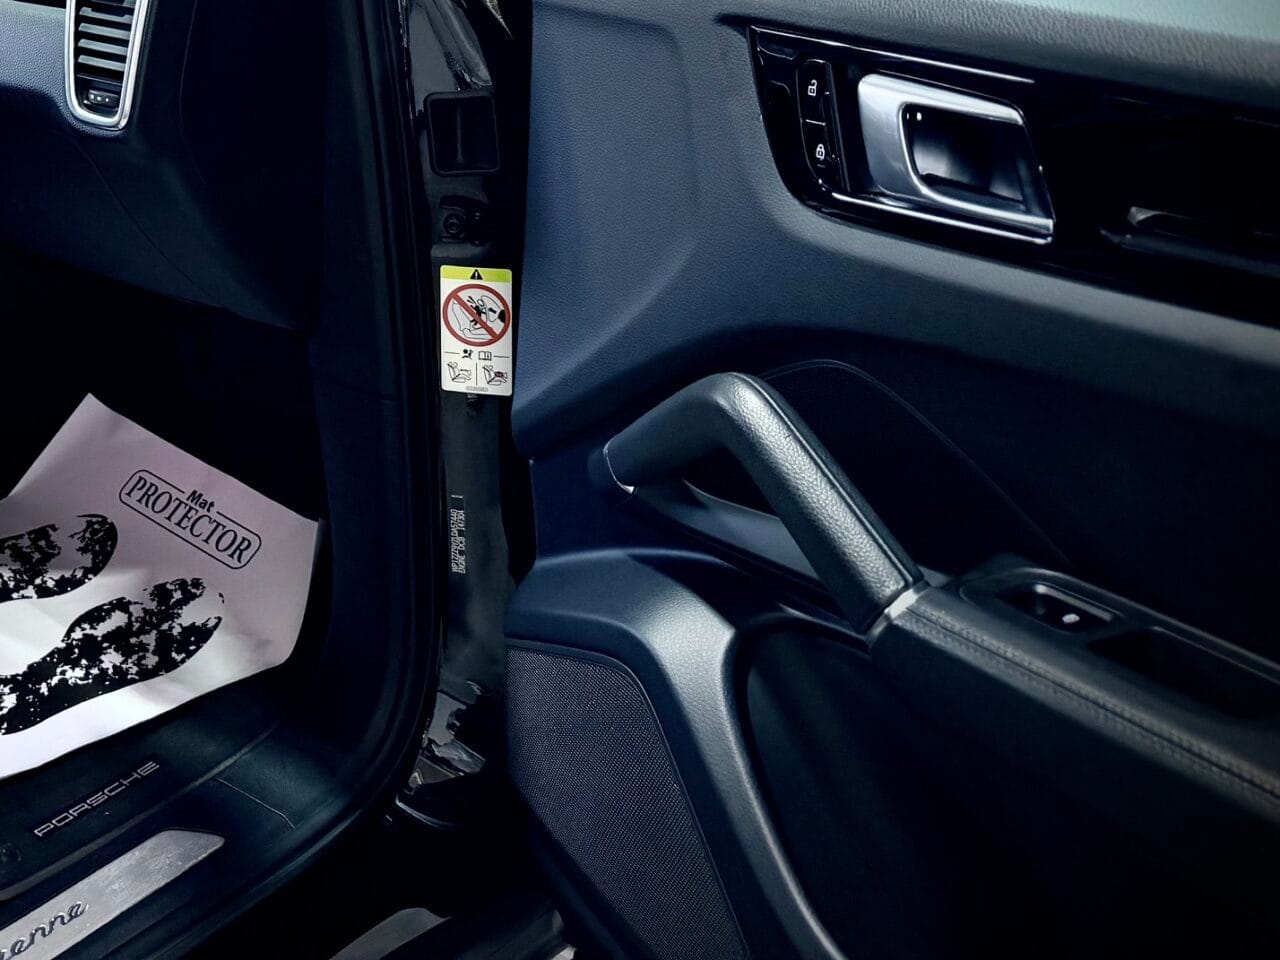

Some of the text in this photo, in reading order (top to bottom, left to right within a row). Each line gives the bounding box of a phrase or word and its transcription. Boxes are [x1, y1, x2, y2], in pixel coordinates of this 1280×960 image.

[124, 475, 252, 564] PROTECTOR
[186, 489, 215, 513] Mat
[33, 760, 161, 838] PORSCHE
